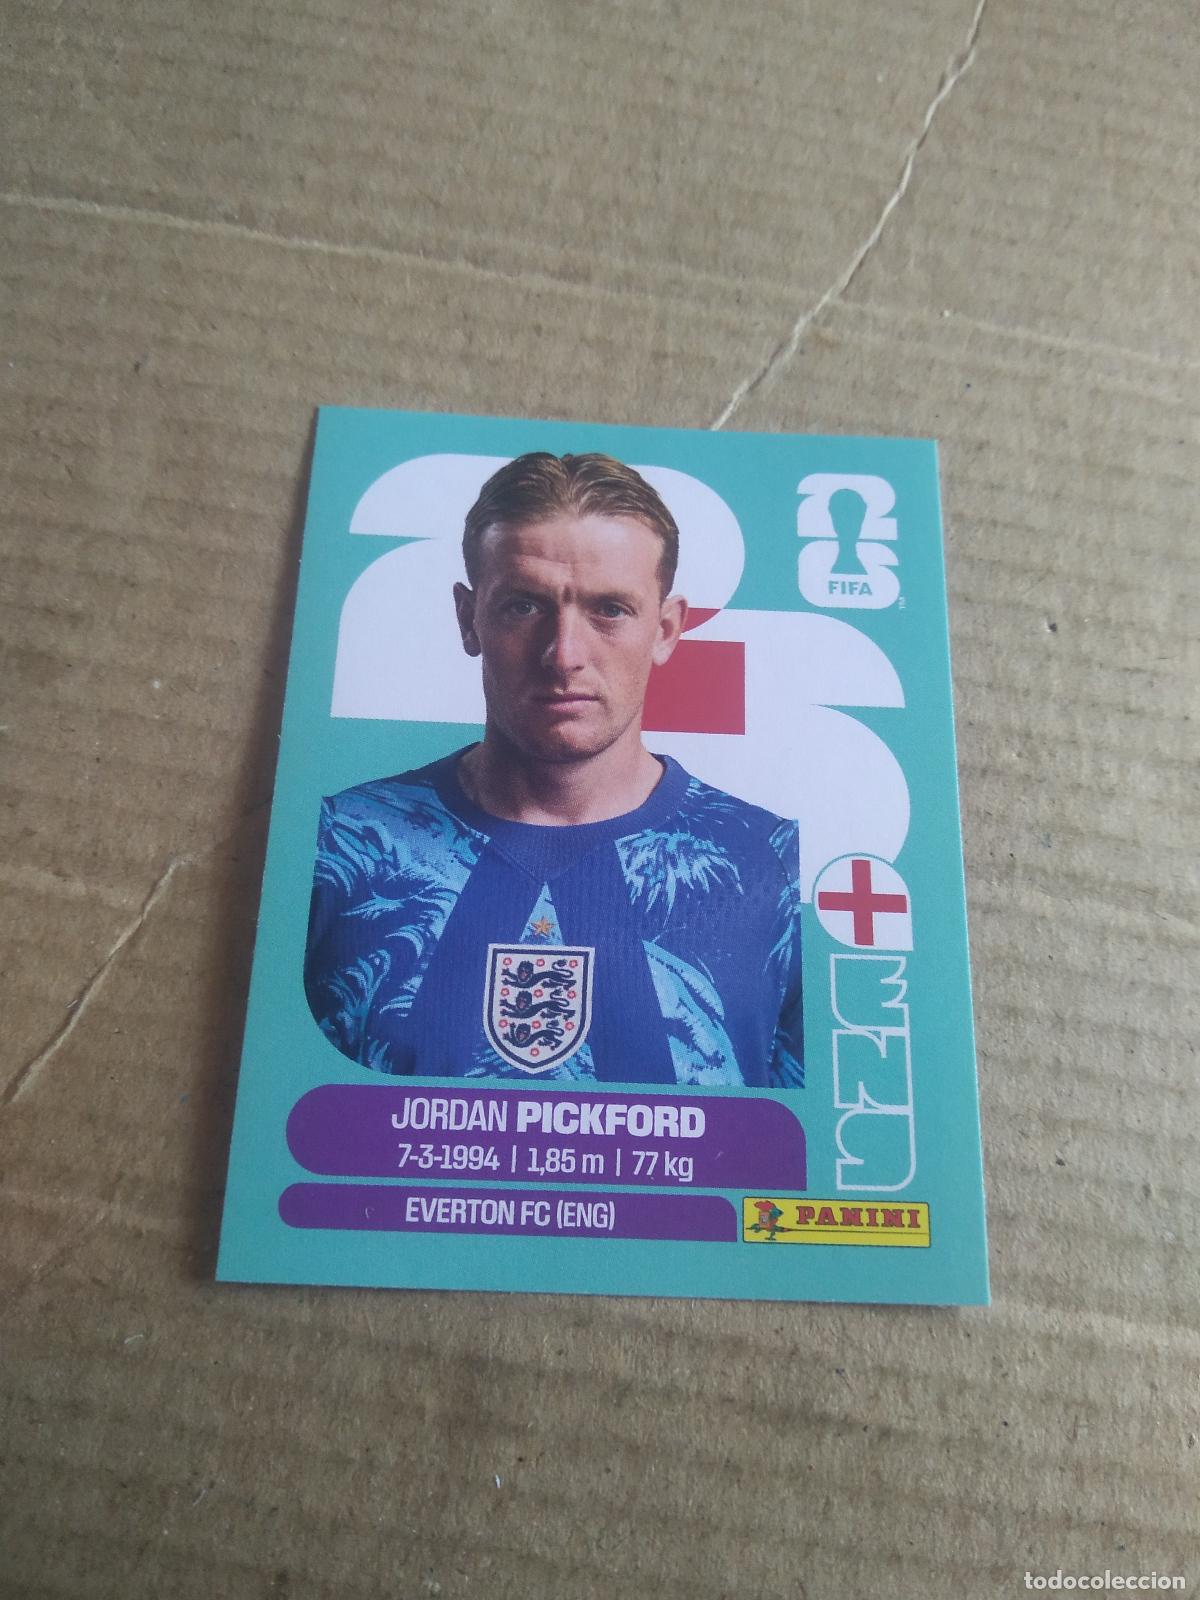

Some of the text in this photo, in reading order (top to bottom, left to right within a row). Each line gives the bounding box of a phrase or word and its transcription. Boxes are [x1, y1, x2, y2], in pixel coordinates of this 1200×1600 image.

[828, 580, 873, 596] FIFA
[391, 1097, 706, 1139] JORDAN PICKFORD
[397, 1143, 500, 1172] 7-3-1994
[527, 1148, 576, 1176] 1,85
[581, 1153, 605, 1174] m
[632, 1150, 659, 1177] 77
[664, 1151, 694, 1182] kg
[405, 1197, 616, 1231] EVERTON FC (ENG)
[795, 1205, 922, 1229] PANINI
